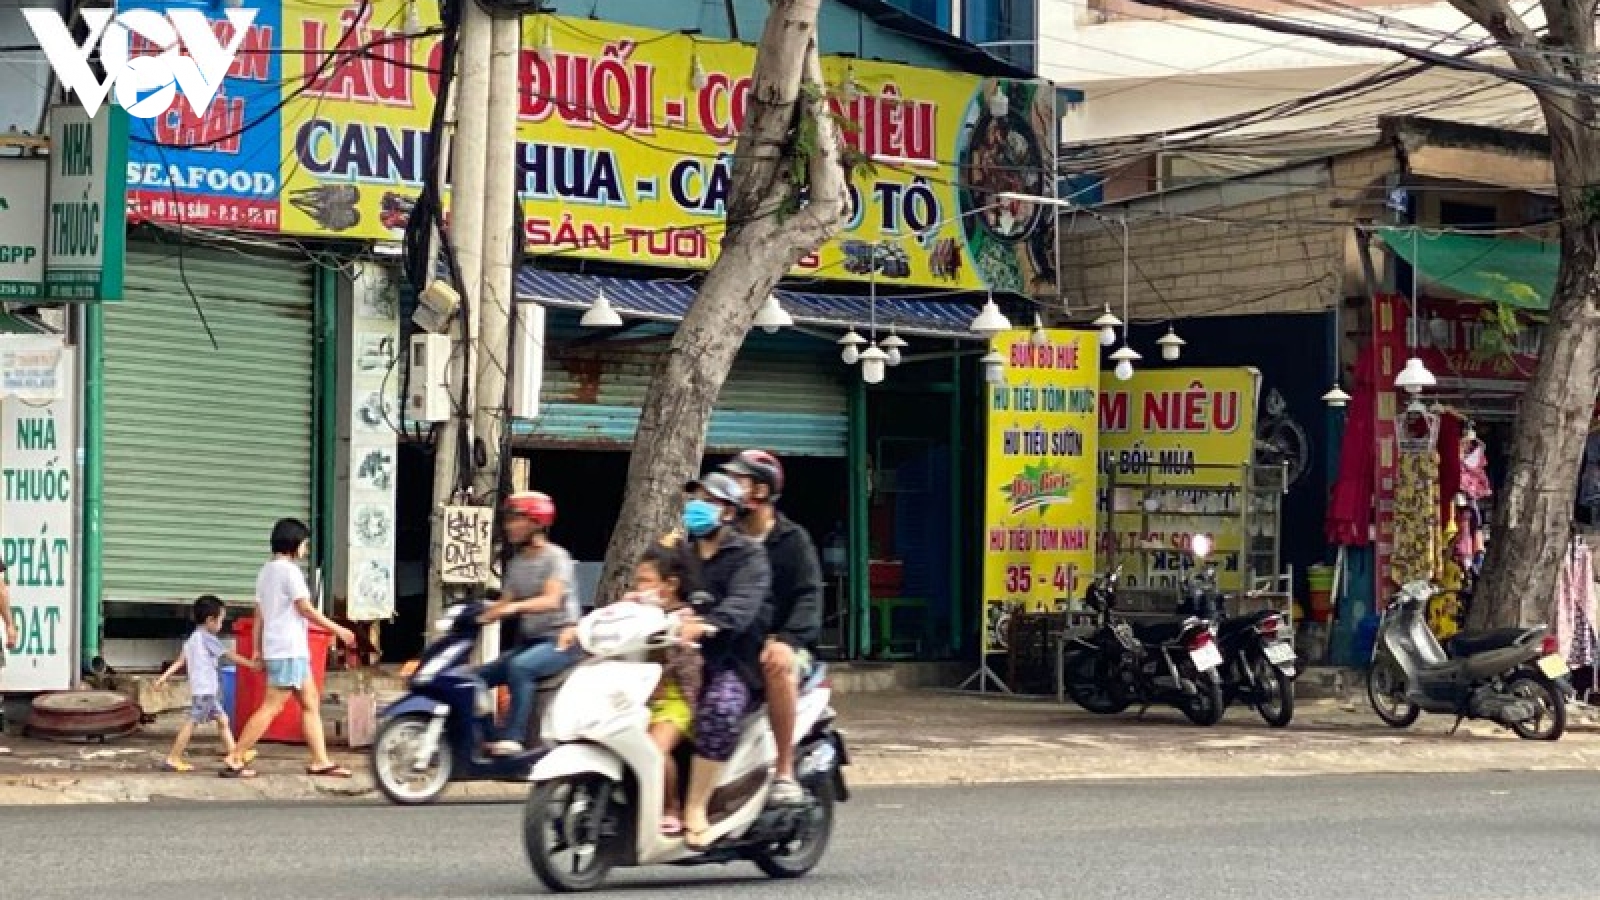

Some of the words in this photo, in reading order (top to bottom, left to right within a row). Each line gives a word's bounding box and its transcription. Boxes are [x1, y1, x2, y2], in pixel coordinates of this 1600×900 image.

[517, 40, 653, 135] ĐUỐI
[126, 161, 274, 194] SEAFOOD
[296, 119, 440, 187] CAN
[517, 142, 626, 206] HUA
[51, 182, 98, 257] THUỐC
[17, 407, 57, 451] NHÀ
[1143, 380, 1240, 433] NIÊU
[3, 456, 70, 501] THUỐC
[1, 522, 69, 587] PHÁT
[1006, 564, 1032, 593] 35
